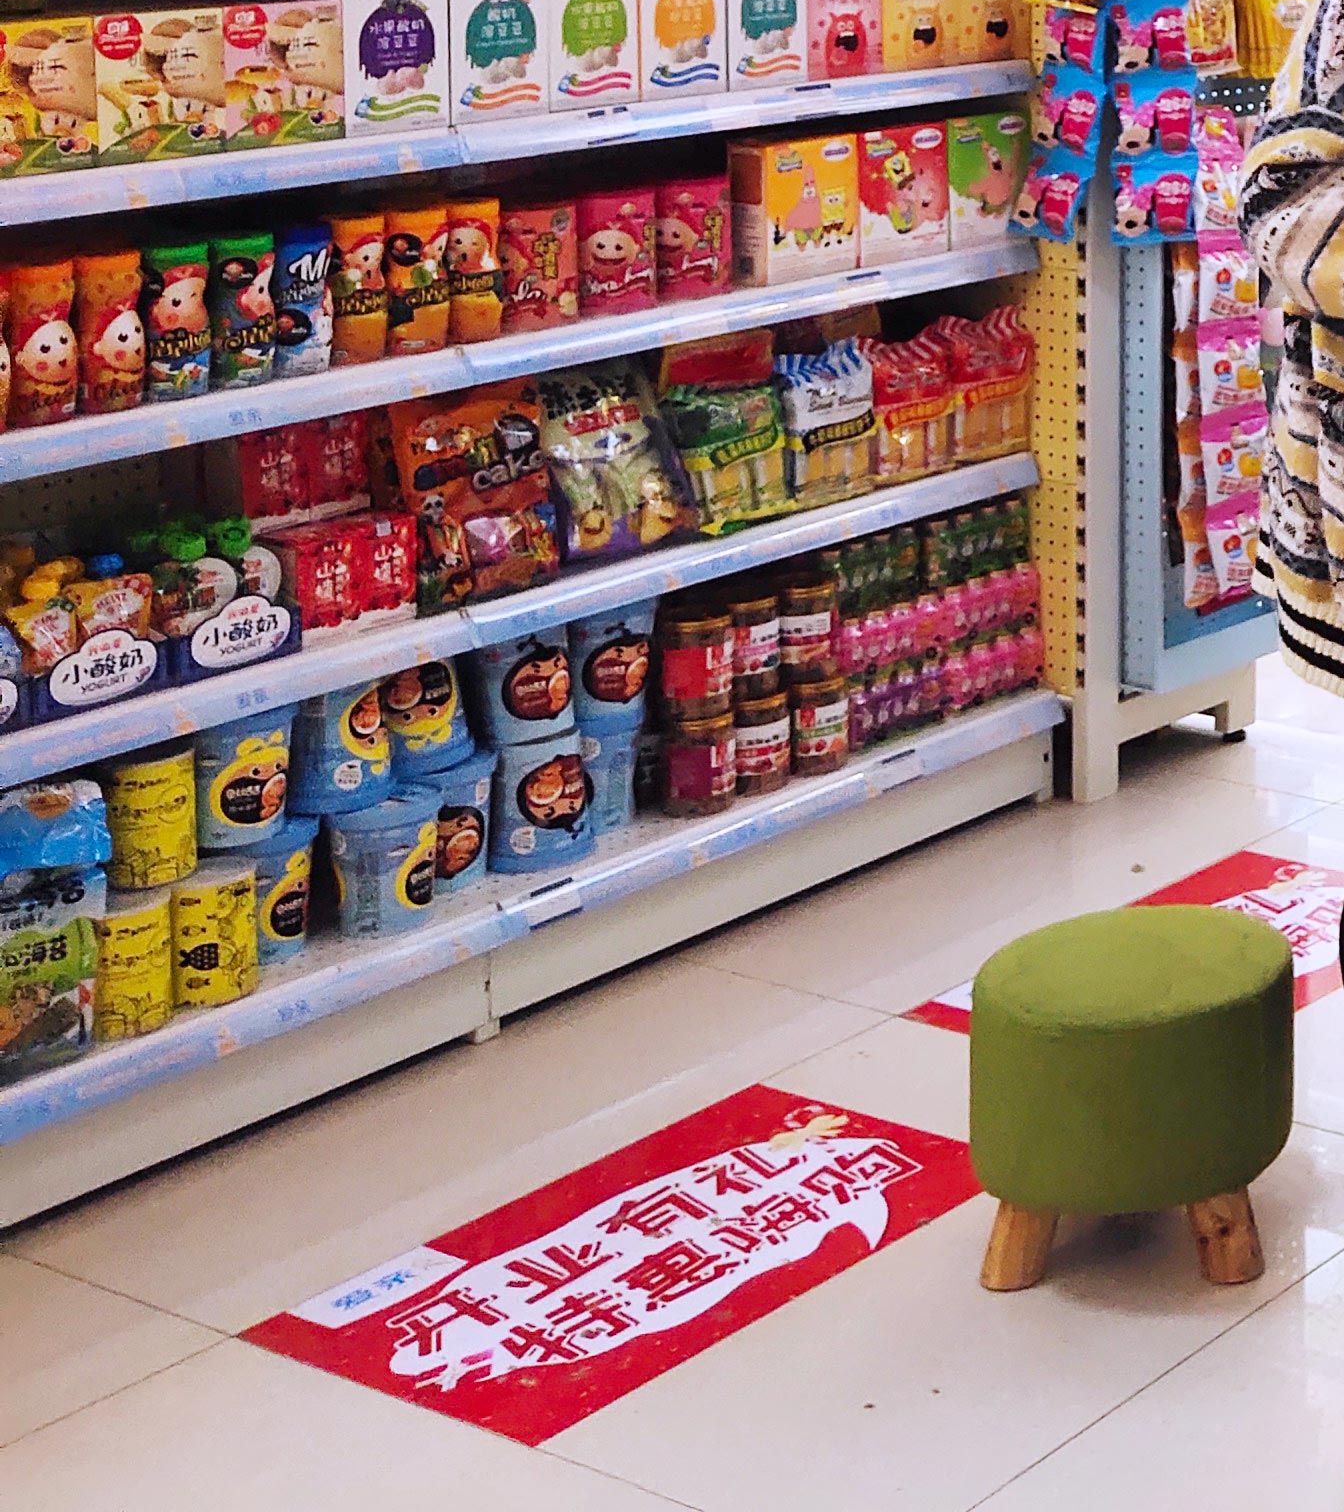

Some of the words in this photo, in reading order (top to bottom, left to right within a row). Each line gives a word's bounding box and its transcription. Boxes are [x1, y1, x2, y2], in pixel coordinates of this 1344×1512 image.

[203, 613, 279, 648] 小酸奶
[62, 648, 144, 685] 小酸奶
[385, 1144, 802, 1357] 开业有礼
